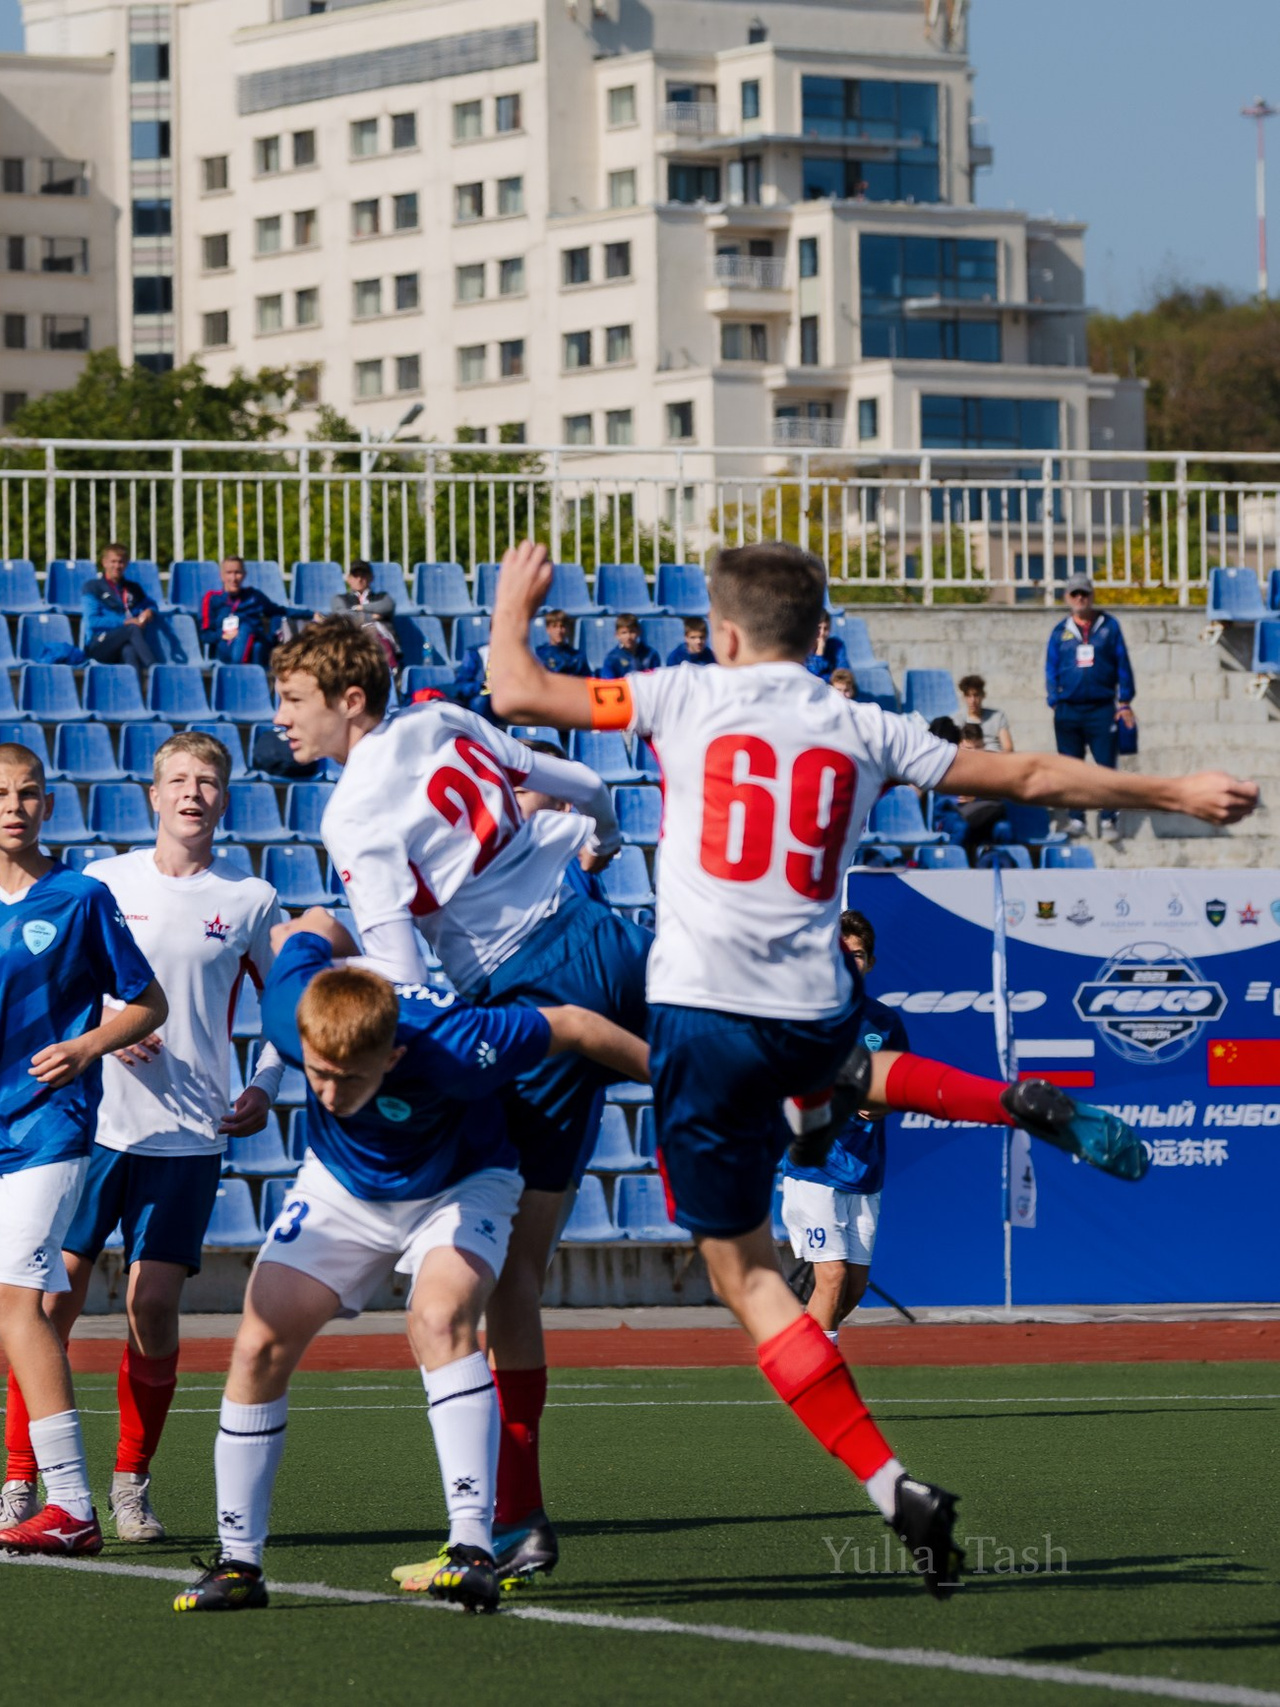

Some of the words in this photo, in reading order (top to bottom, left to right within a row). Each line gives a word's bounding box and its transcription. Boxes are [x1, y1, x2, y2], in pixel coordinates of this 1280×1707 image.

[700, 735, 858, 902] 69
[1089, 990, 1213, 1012] FESCO
[806, 1227, 826, 1249] 29
